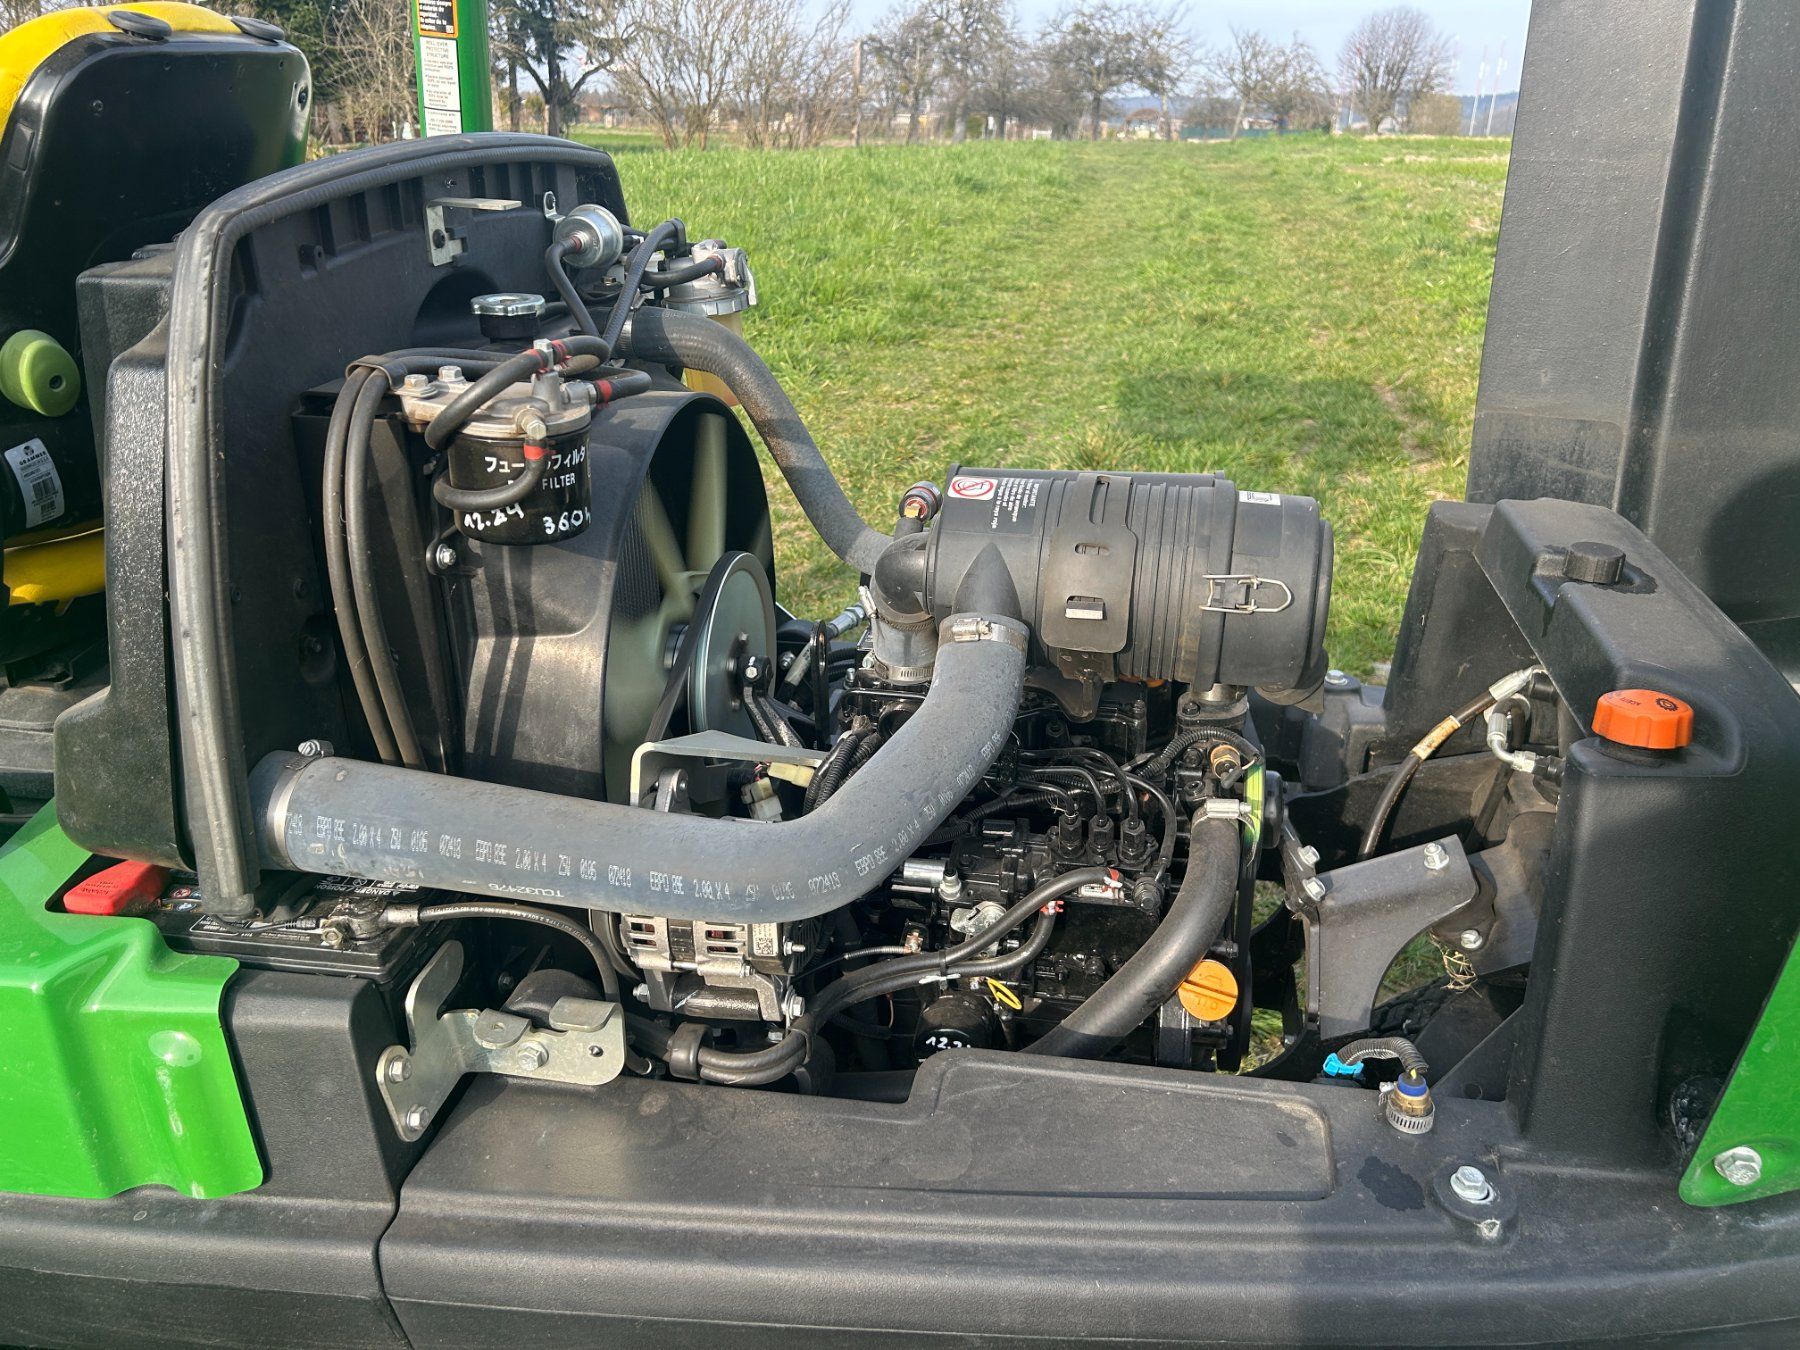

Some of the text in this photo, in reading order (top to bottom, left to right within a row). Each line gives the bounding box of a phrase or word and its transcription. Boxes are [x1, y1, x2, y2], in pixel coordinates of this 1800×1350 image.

[542, 472, 576, 490] FILTER
[375, 826, 381, 848] 4
[541, 851, 546, 872] 4
[724, 881, 730, 900] 4
[314, 883, 346, 893] POISON
[354, 887, 391, 896] DANGER
[488, 883, 564, 898] TCU32476
